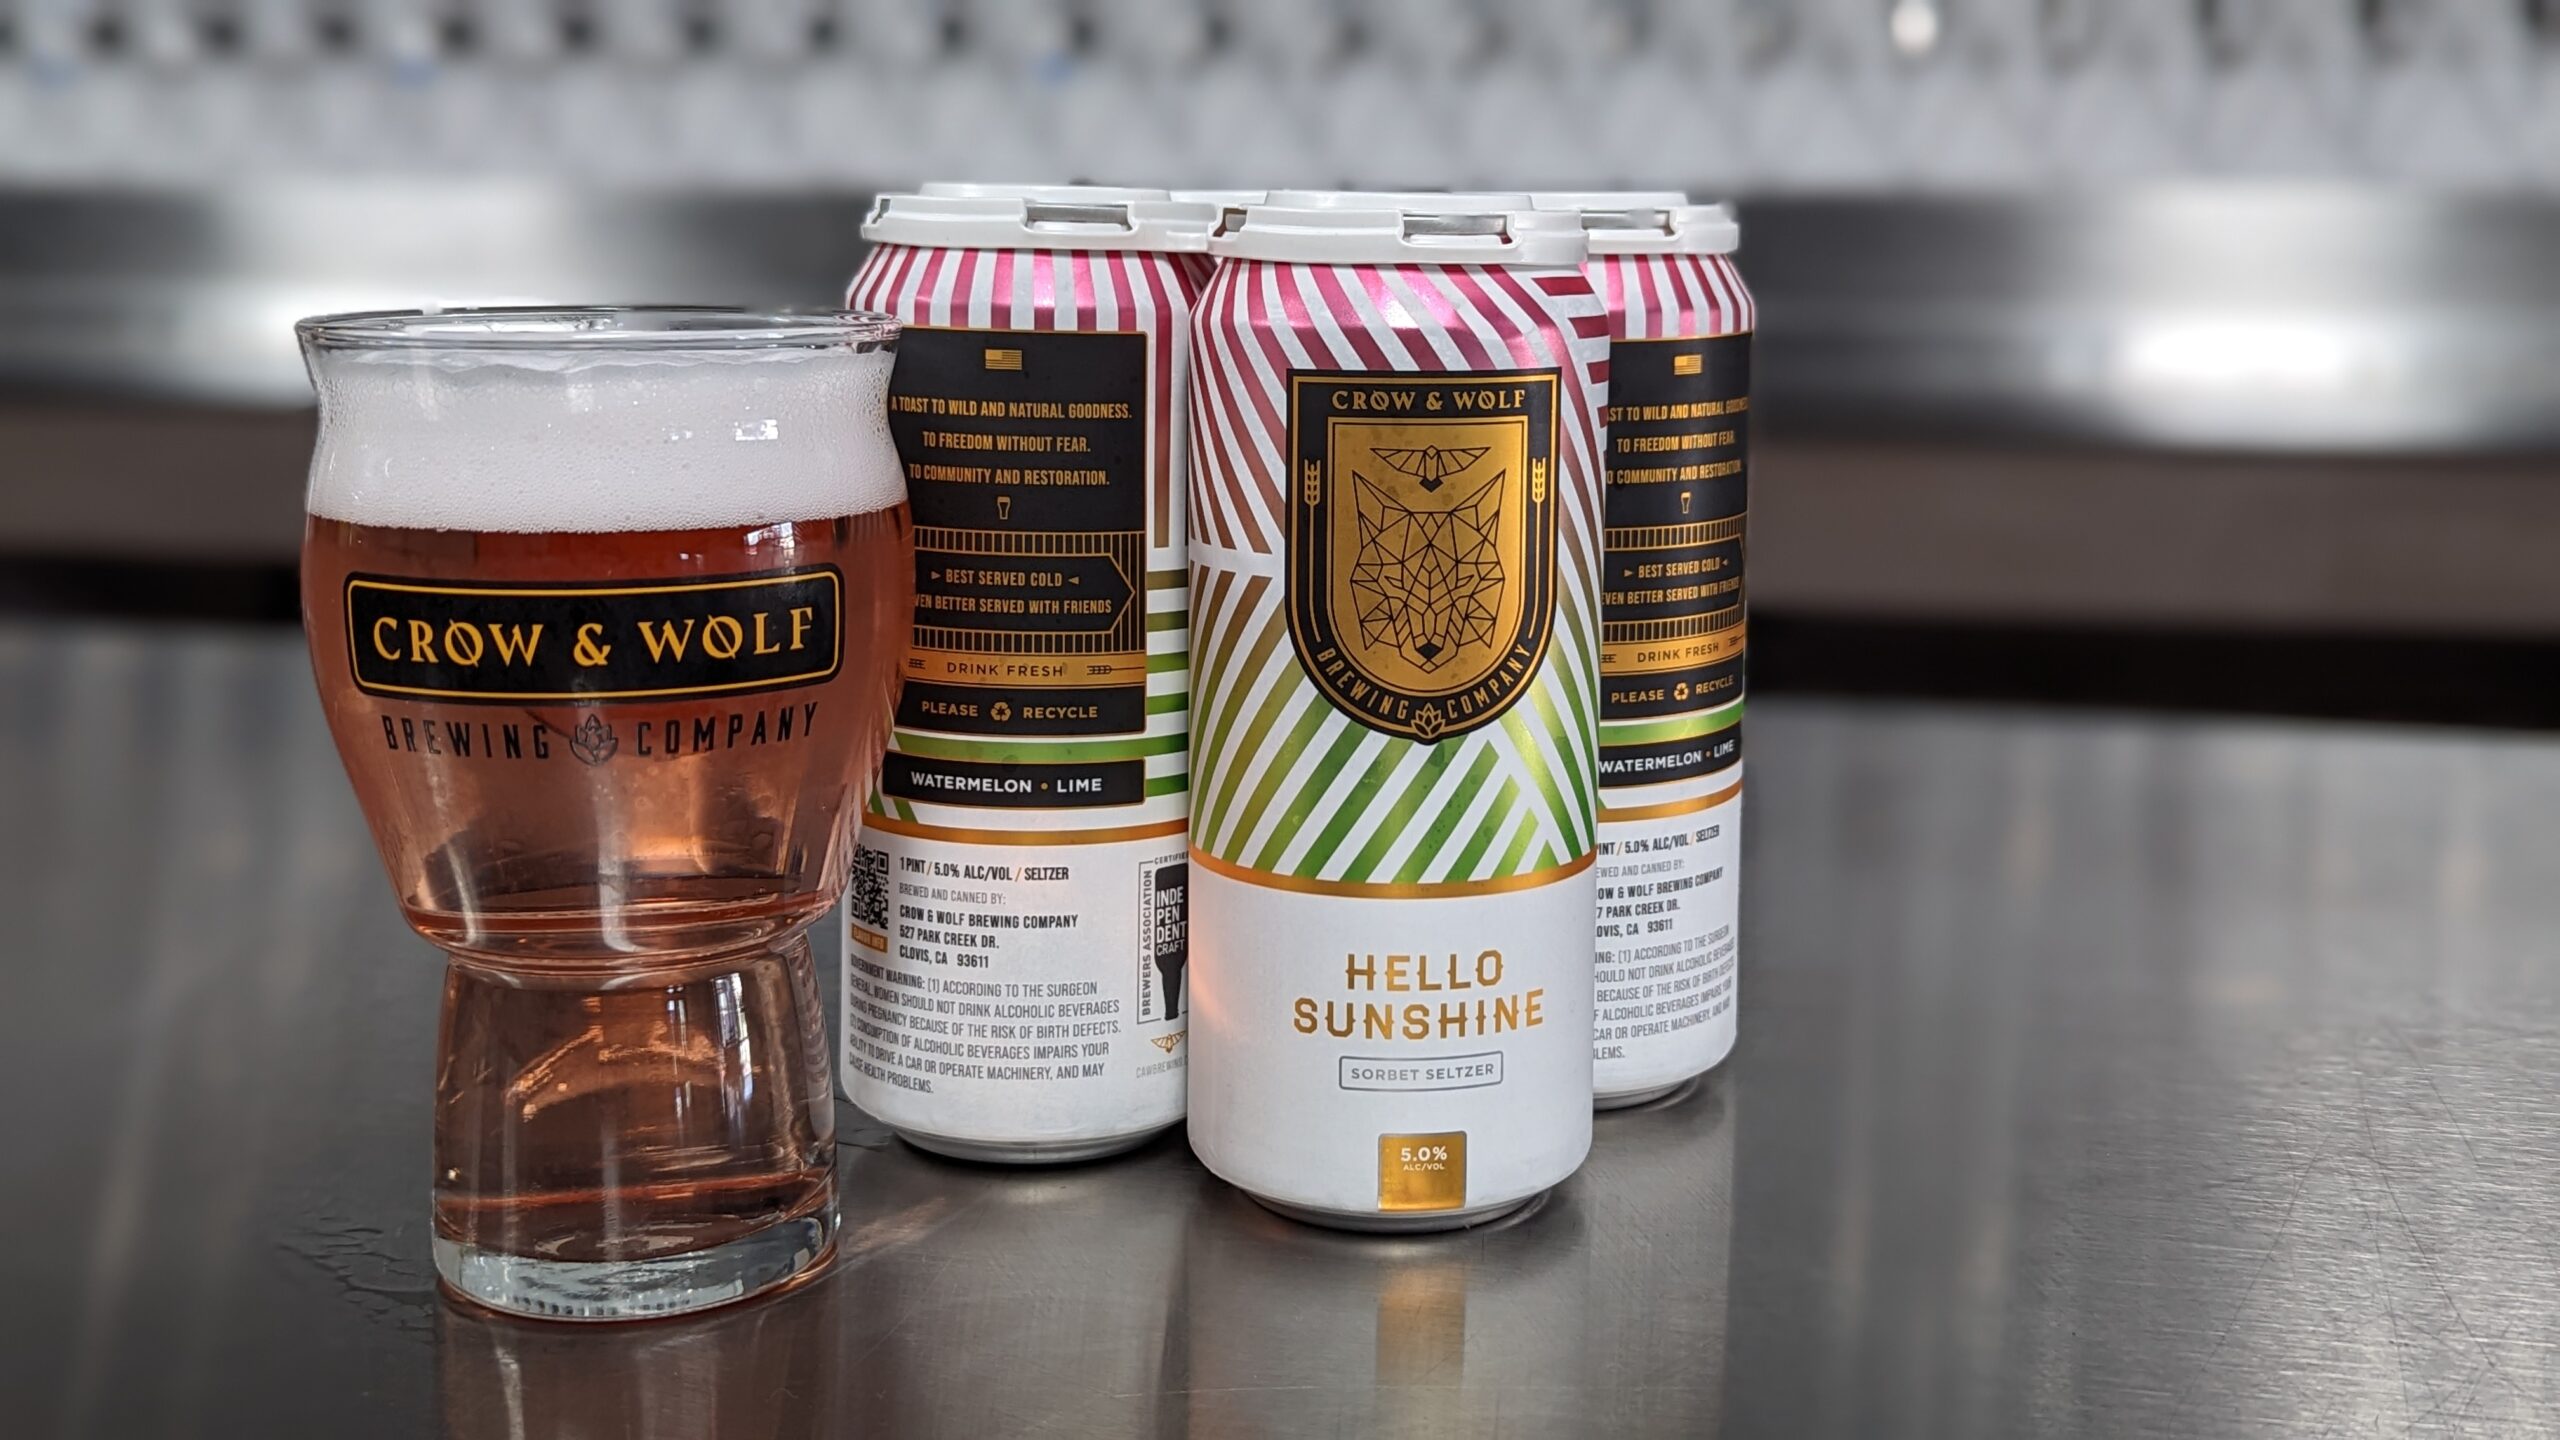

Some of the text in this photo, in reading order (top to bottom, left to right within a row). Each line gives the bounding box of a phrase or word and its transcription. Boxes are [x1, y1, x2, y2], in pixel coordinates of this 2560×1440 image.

[900, 396, 1132, 418] TOAST TO WILD AND NATURAL GOODNESS.
[1332, 390, 1525, 410] CROW & WOLF
[1627, 406, 1639, 420] TO
[1643, 406, 1668, 421] WILD
[1670, 404, 1688, 419] AND
[1691, 401, 1724, 417] NATURAL
[923, 431, 1090, 452] TO FREEDOM WITHOUT FEAR.
[1617, 433, 1717, 453] TO FREEDOM WITHOUT
[910, 464, 1110, 485] TO COMMUNITY AND RESTORATION.
[1617, 465, 1698, 484] COMMUNITY AND
[946, 569, 1062, 586] BEST SERVED COLD
[1639, 557, 1720, 578] BEST SERVED COLD
[1628, 582, 1717, 604] BETTER SERVED WITH
[935, 596, 1112, 614] BETTER SERVED WITH FRIENDS
[374, 607, 814, 667] CROW & WOLF
[1637, 643, 1719, 663] DRINK FRESH
[947, 662, 1063, 677] DRINK FRESH
[1317, 644, 1531, 719] BREWING COMPANY
[1611, 675, 1734, 703] PLEASE RECYCLE
[922, 701, 1098, 719] PLEASE RECYCLE
[382, 702, 818, 759] BREWING COMPANY
[1599, 739, 1734, 773] WATERMELON LIME
[911, 772, 1102, 792] WATERMELON LIME
[1625, 834, 1688, 853] 5.0% ALC/VOL
[907, 858, 1069, 881] PINT 5.0% ALC/VOL SELTZER
[1621, 861, 1671, 876] AND CANNED
[900, 883, 1006, 904] BREWED AND CANNED BY:
[1618, 867, 1723, 898] & WOLF BREWING COMPANY
[1157, 886, 1183, 908] INDE
[900, 905, 1078, 928] CROW & WOLF BREWING COMPANY
[1156, 907, 1180, 925] PEN
[1606, 903, 1632, 918] PARK
[1635, 901, 1664, 915] CREEK
[900, 925, 915, 939] 527
[917, 928, 941, 944] PARK
[944, 932, 977, 948] CREEK
[981, 934, 999, 948] DR.
[1156, 921, 1187, 943] DENT
[1627, 919, 1672, 935] CA 93611
[1142, 870, 1152, 1016] BREWERS ASSOCIATION
[1156, 940, 1185, 956] CRAFT
[1634, 942, 1681, 960] ACCORDING
[1684, 940, 1693, 952] TO
[1695, 936, 1706, 949] THE
[900, 945, 989, 968] CLOVIS, CA 93611
[1345, 950, 1504, 991] HELLO
[1628, 963, 1674, 980] NOT DRINK
[886, 968, 1098, 998] WARNING: (1) ACCORDING TO THE SURGEON
[1597, 977, 1690, 1002] BECAUSE OF THE RISK
[874, 986, 1120, 1018] WOMEN SHOULD NOT DRINK ALCOHOLIC BEVERAGES
[1603, 994, 1699, 1021] ALCOHOLIC BEVERAGES
[868, 1003, 1121, 1039] PREGNANCY BECAUSE OF THE RISK OF BIRTH DEFECTS.
[1294, 988, 1544, 1040] SUNSHINE
[1615, 1020, 1668, 1039] OR OPERATE
[902, 1034, 1109, 1059] OF ALCOHOLIC BEVERAGES IMPAIRS YOUR
[876, 1046, 1104, 1080] DRIVE A CAR OR OPERATE MACHINERY, AND MAY
[1351, 1063, 1494, 1080] SORBET SELTZER
[864, 1061, 933, 1093] HEALTH PROBLEMS.
[1401, 1146, 1447, 1162] 5.0%
[1403, 1163, 1445, 1171] ALC/VOL
